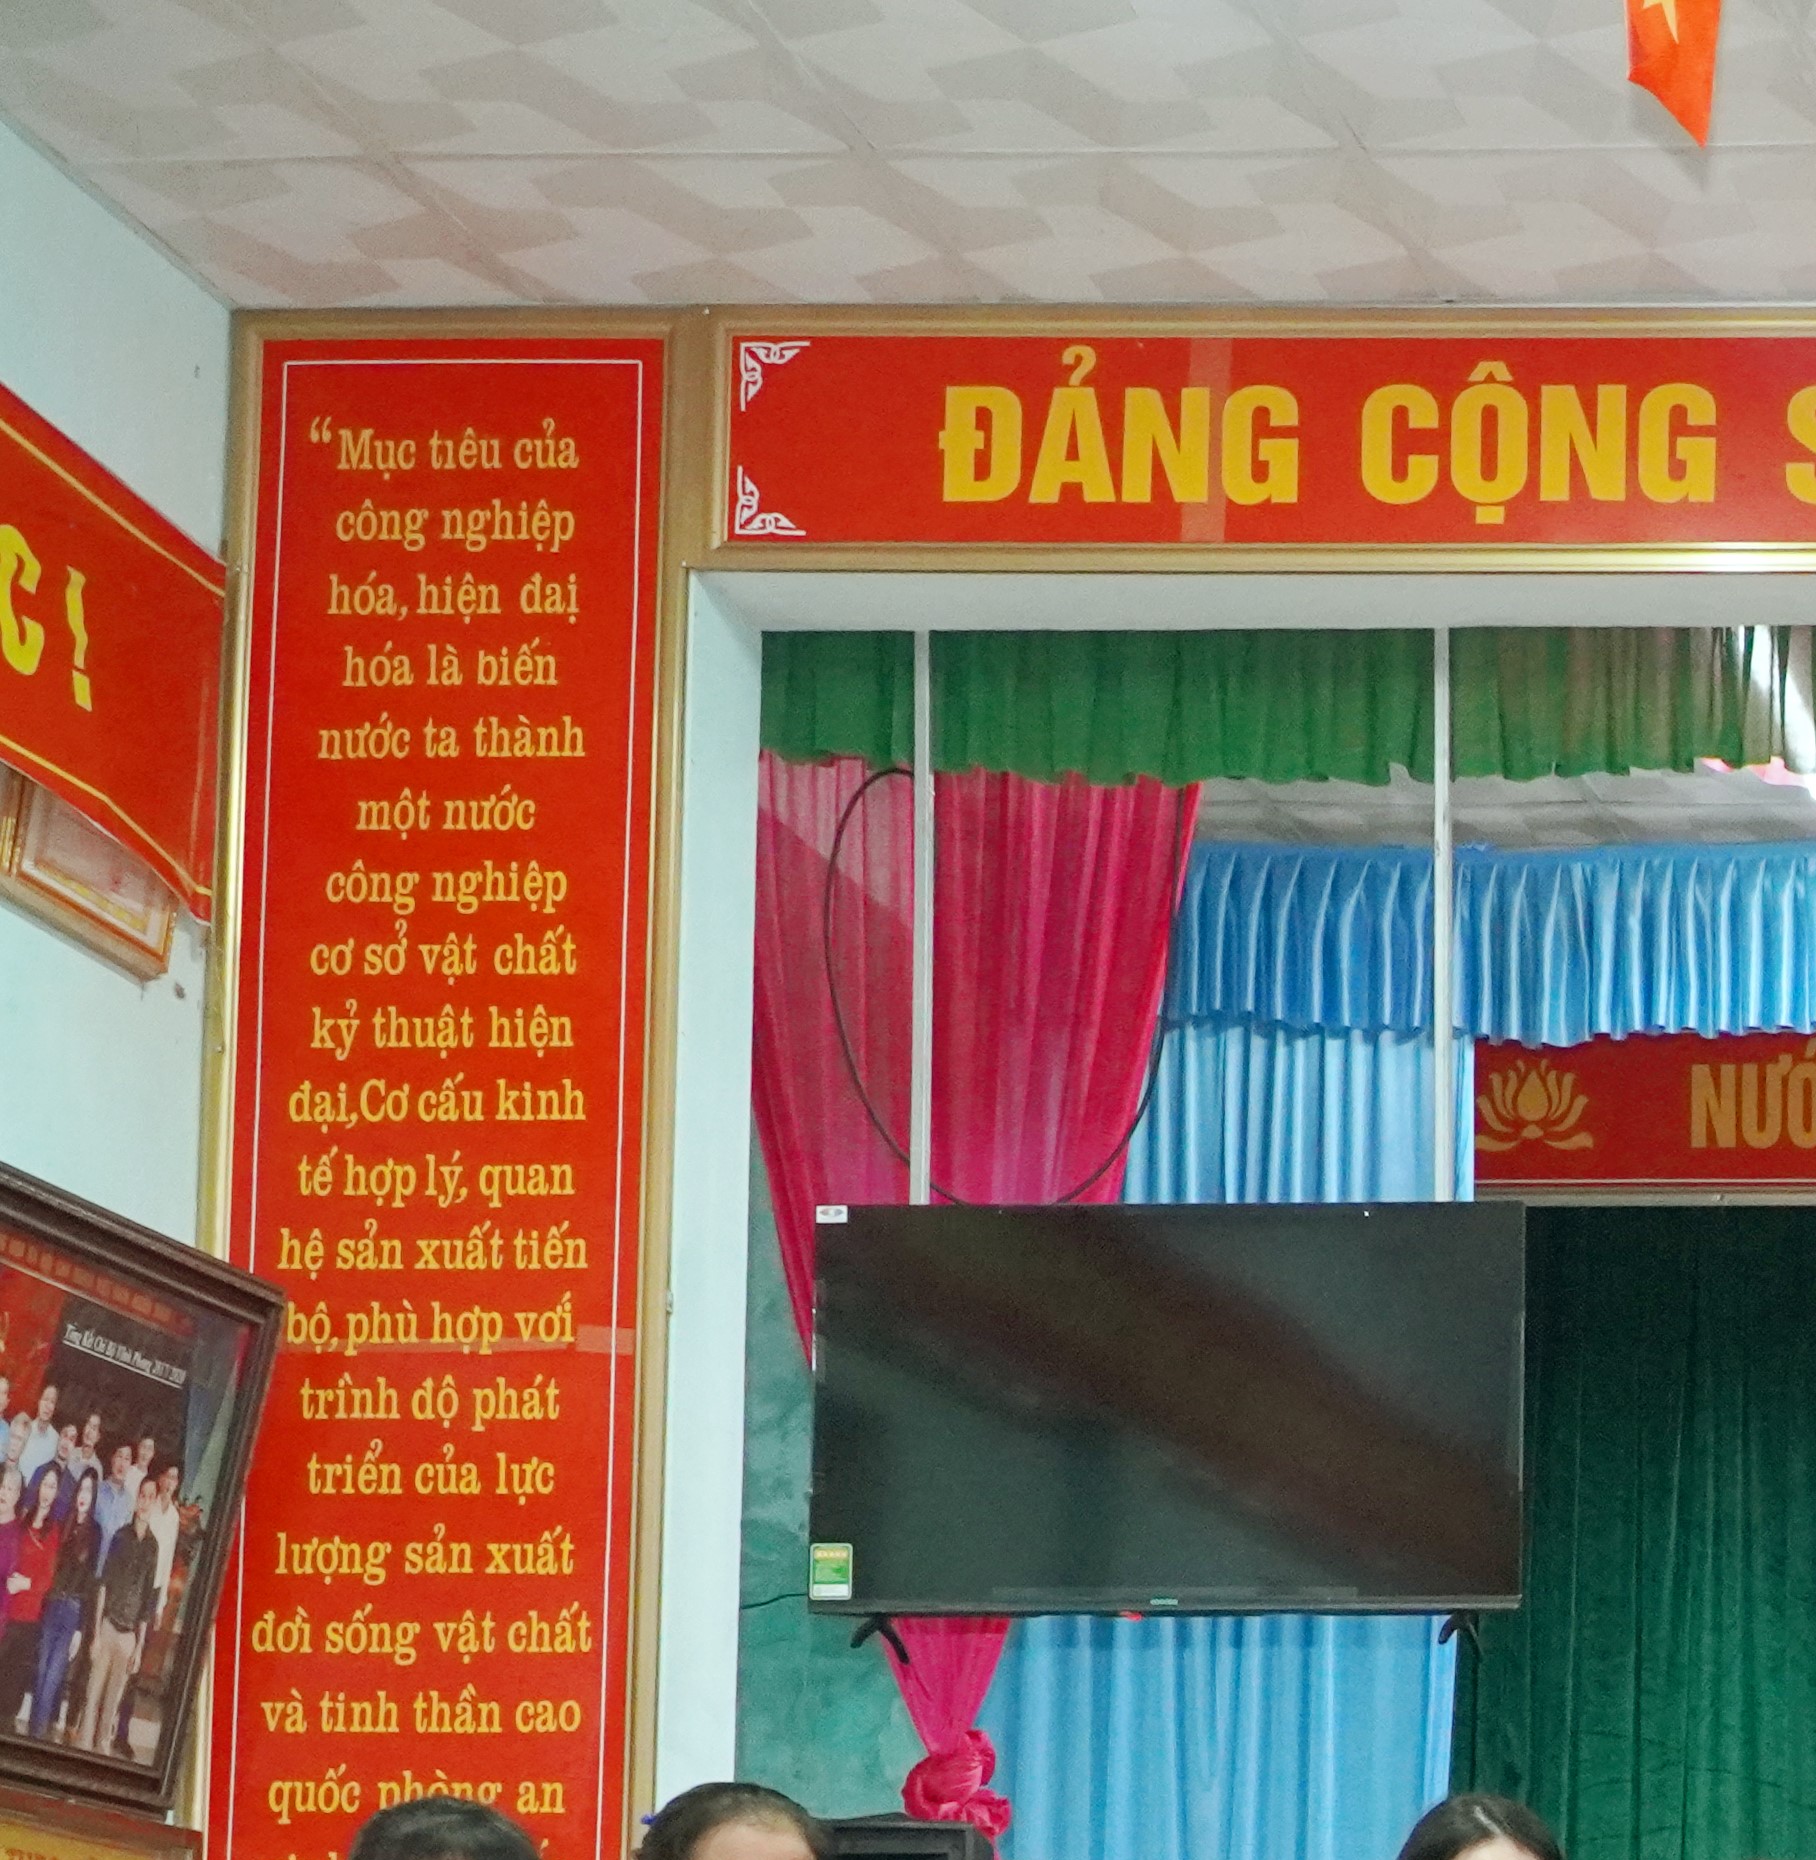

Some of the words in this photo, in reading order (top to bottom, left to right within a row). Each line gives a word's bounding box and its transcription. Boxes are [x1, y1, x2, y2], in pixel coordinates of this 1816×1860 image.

[429, 428, 502, 469] tiêu
[514, 418, 579, 469] của
[939, 346, 1299, 507] ĐẢNG
[1361, 361, 1719, 524] CỘNG
[336, 501, 426, 553] công
[442, 499, 575, 552] nghiệp
[328, 571, 407, 620] hóa,
[417, 573, 501, 624] hiện
[343, 641, 414, 686] hóa
[427, 644, 463, 686] là
[318, 712, 410, 759] nước
[424, 718, 459, 757] ta
[474, 715, 585, 757] thành
[356, 788, 430, 840] một
[443, 784, 535, 831] nước
[326, 859, 420, 915] công
[432, 860, 567, 914] nghiệp
[310, 938, 354, 975] cơ
[364, 919, 408, 975] sở
[418, 932, 477, 985] vật
[494, 924, 577, 975] chất
[372, 1004, 474, 1059] thuật
[489, 1004, 574, 1057] hiện
[418, 1072, 484, 1122] cấu
[495, 1078, 586, 1121] kinh
[298, 1145, 338, 1196] tế
[343, 1154, 416, 1208] hợp
[425, 1150, 468, 1208] lý,
[479, 1164, 576, 1208] quan
[277, 1228, 324, 1280] hệ
[336, 1218, 404, 1270] sản
[414, 1220, 504, 1270] xuất
[513, 1220, 588, 1270] tiến
[346, 1300, 417, 1356] phù
[431, 1301, 502, 1355] hợp
[515, 1292, 574, 1344] với
[300, 1372, 400, 1419] trình
[411, 1374, 459, 1428] độ
[471, 1374, 560, 1432] phát
[307, 1439, 403, 1494] triển
[415, 1443, 481, 1494] của
[496, 1452, 554, 1505] lực
[275, 1532, 392, 1586] lượng
[405, 1523, 473, 1574] sản
[485, 1525, 574, 1575] xuất
[251, 1606, 311, 1654] đời
[325, 1603, 421, 1666] sống
[433, 1609, 496, 1664] vật
[507, 1601, 592, 1653] chất
[261, 1688, 307, 1733] và
[319, 1690, 399, 1733] tinh
[413, 1683, 503, 1734] thần
[515, 1700, 582, 1733] cao
[268, 1763, 361, 1824] quốc
[516, 1781, 566, 1814] an
